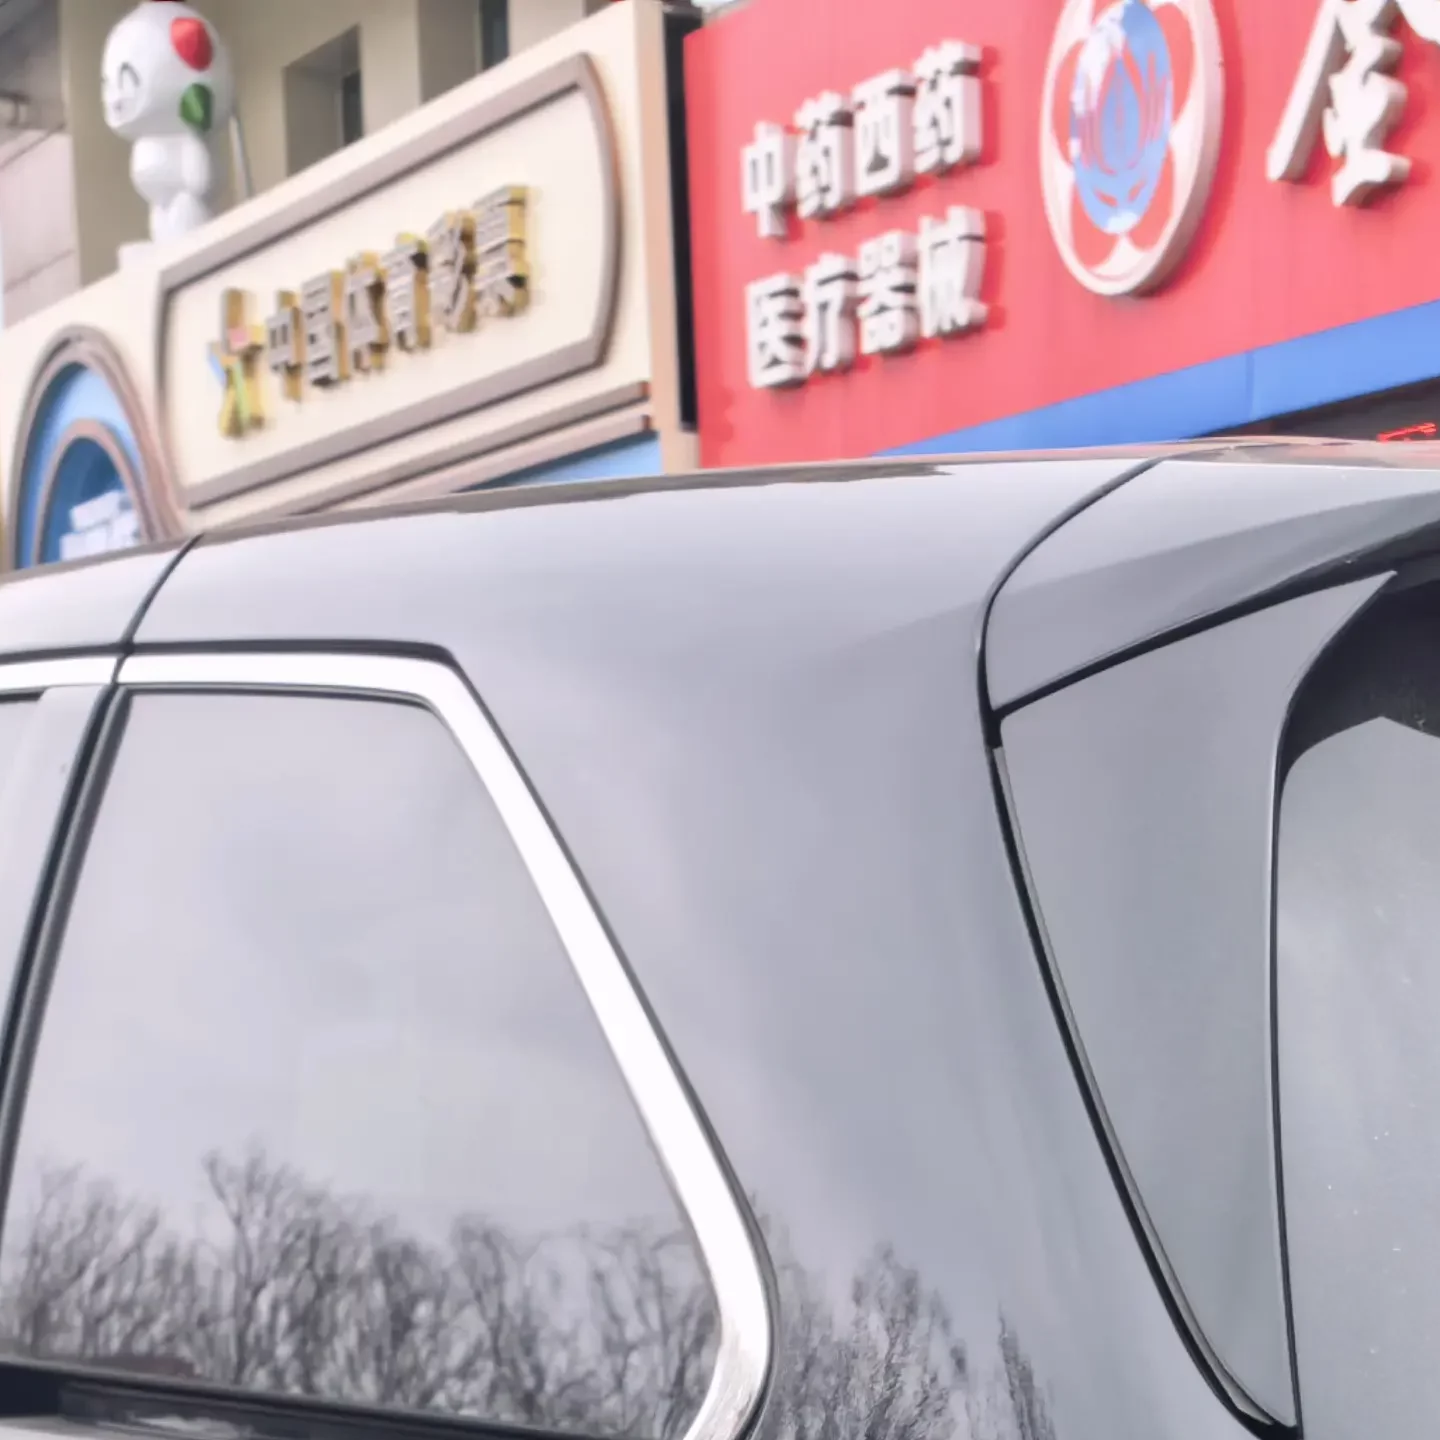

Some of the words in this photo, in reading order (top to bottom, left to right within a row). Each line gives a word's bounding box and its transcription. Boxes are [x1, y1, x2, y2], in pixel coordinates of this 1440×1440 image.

[741, 38, 982, 238] 中药西药
[746, 204, 988, 390] 医疗器械
